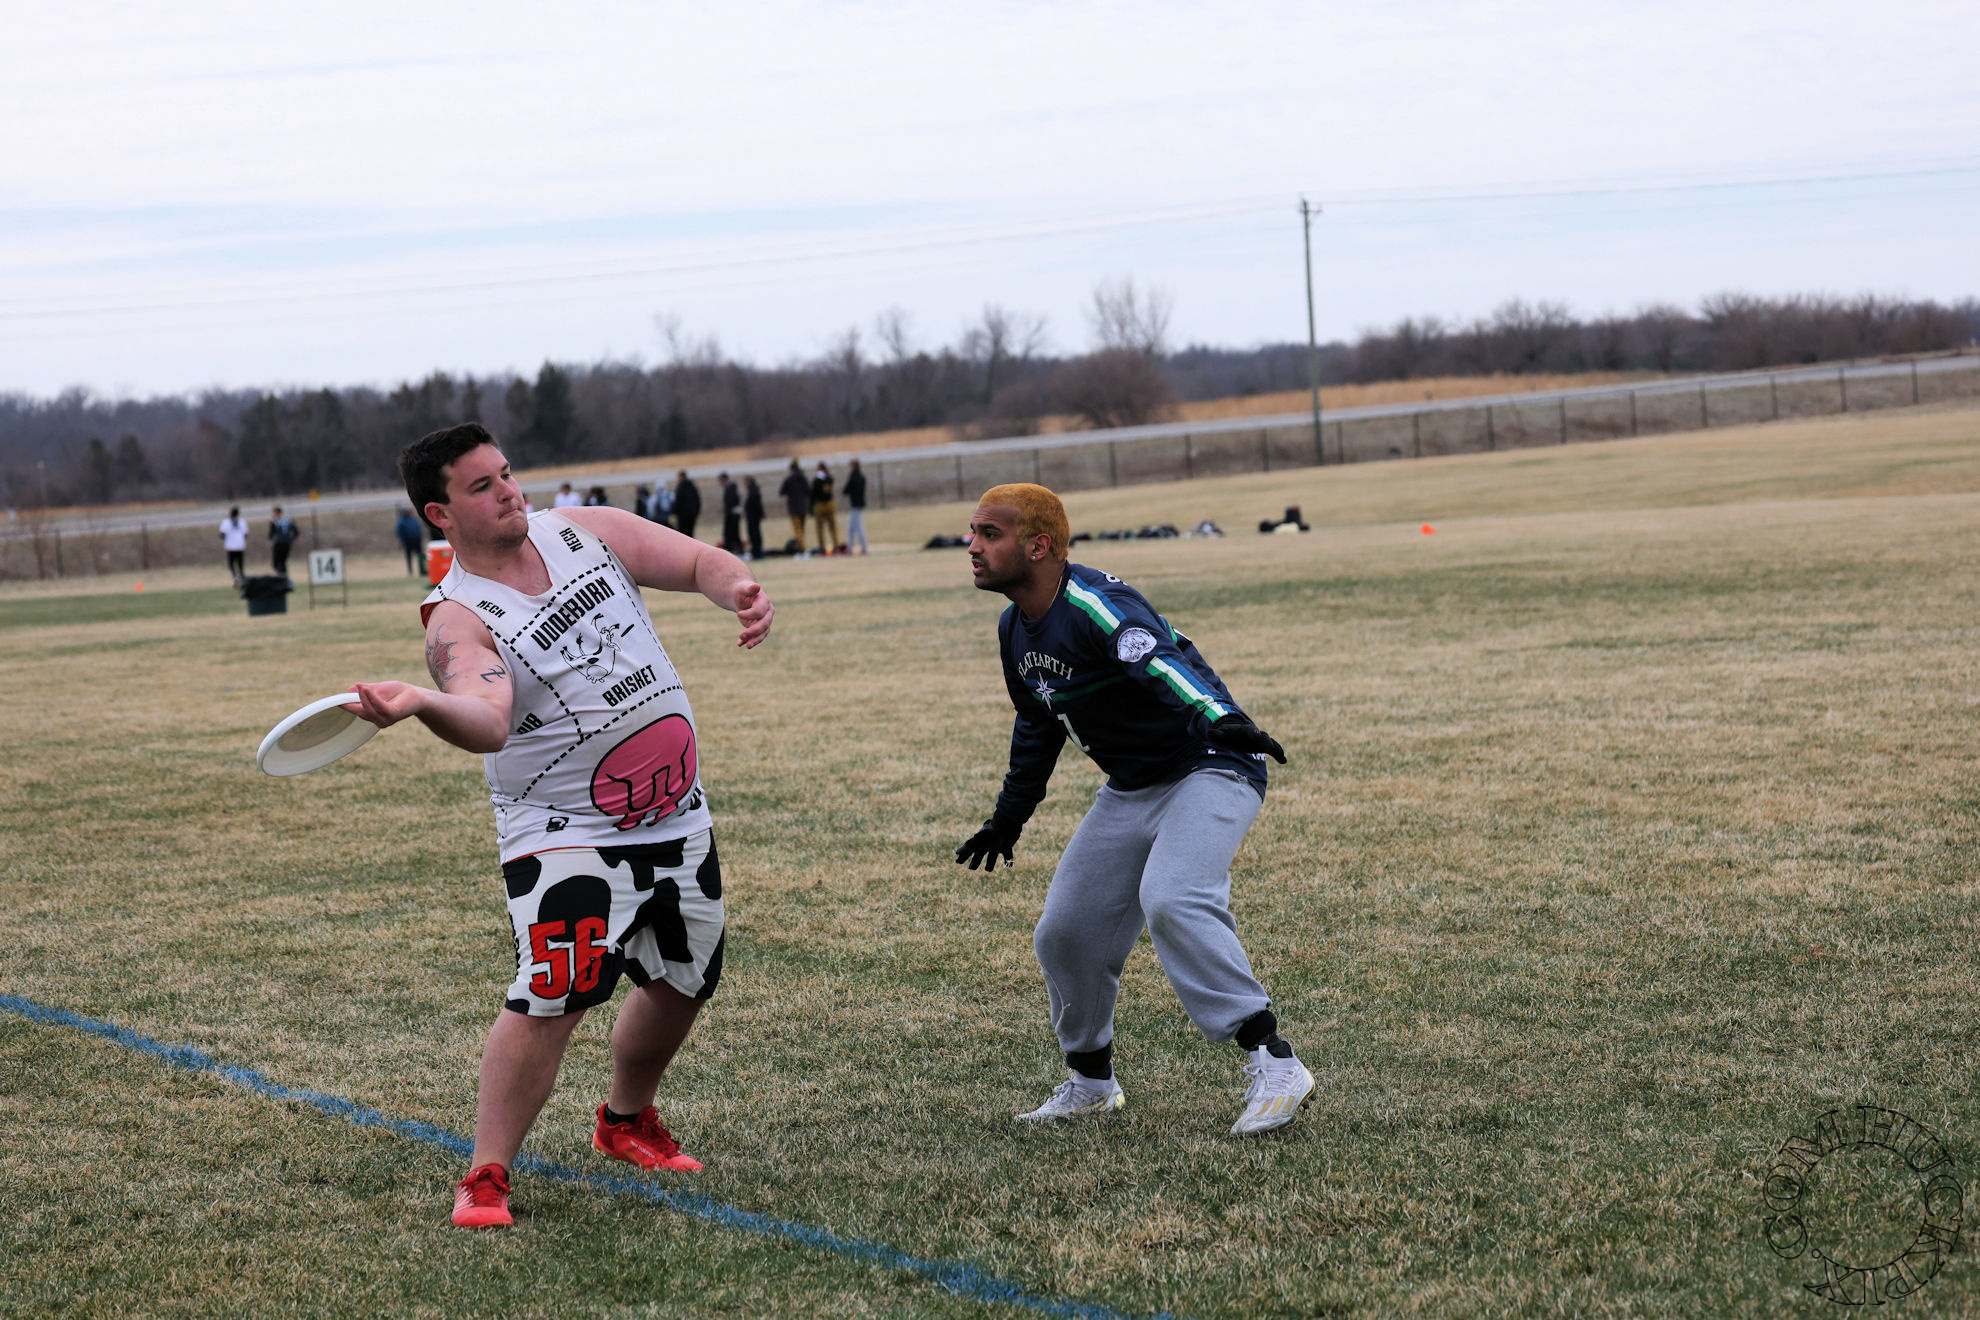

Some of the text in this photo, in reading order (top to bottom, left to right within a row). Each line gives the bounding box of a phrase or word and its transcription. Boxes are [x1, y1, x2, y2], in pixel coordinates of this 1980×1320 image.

[559, 527, 584, 552] NECK
[316, 556, 336, 577] 14
[476, 600, 506, 618] NECK
[602, 664, 657, 707] BRISKET
[528, 916, 608, 999] 56
